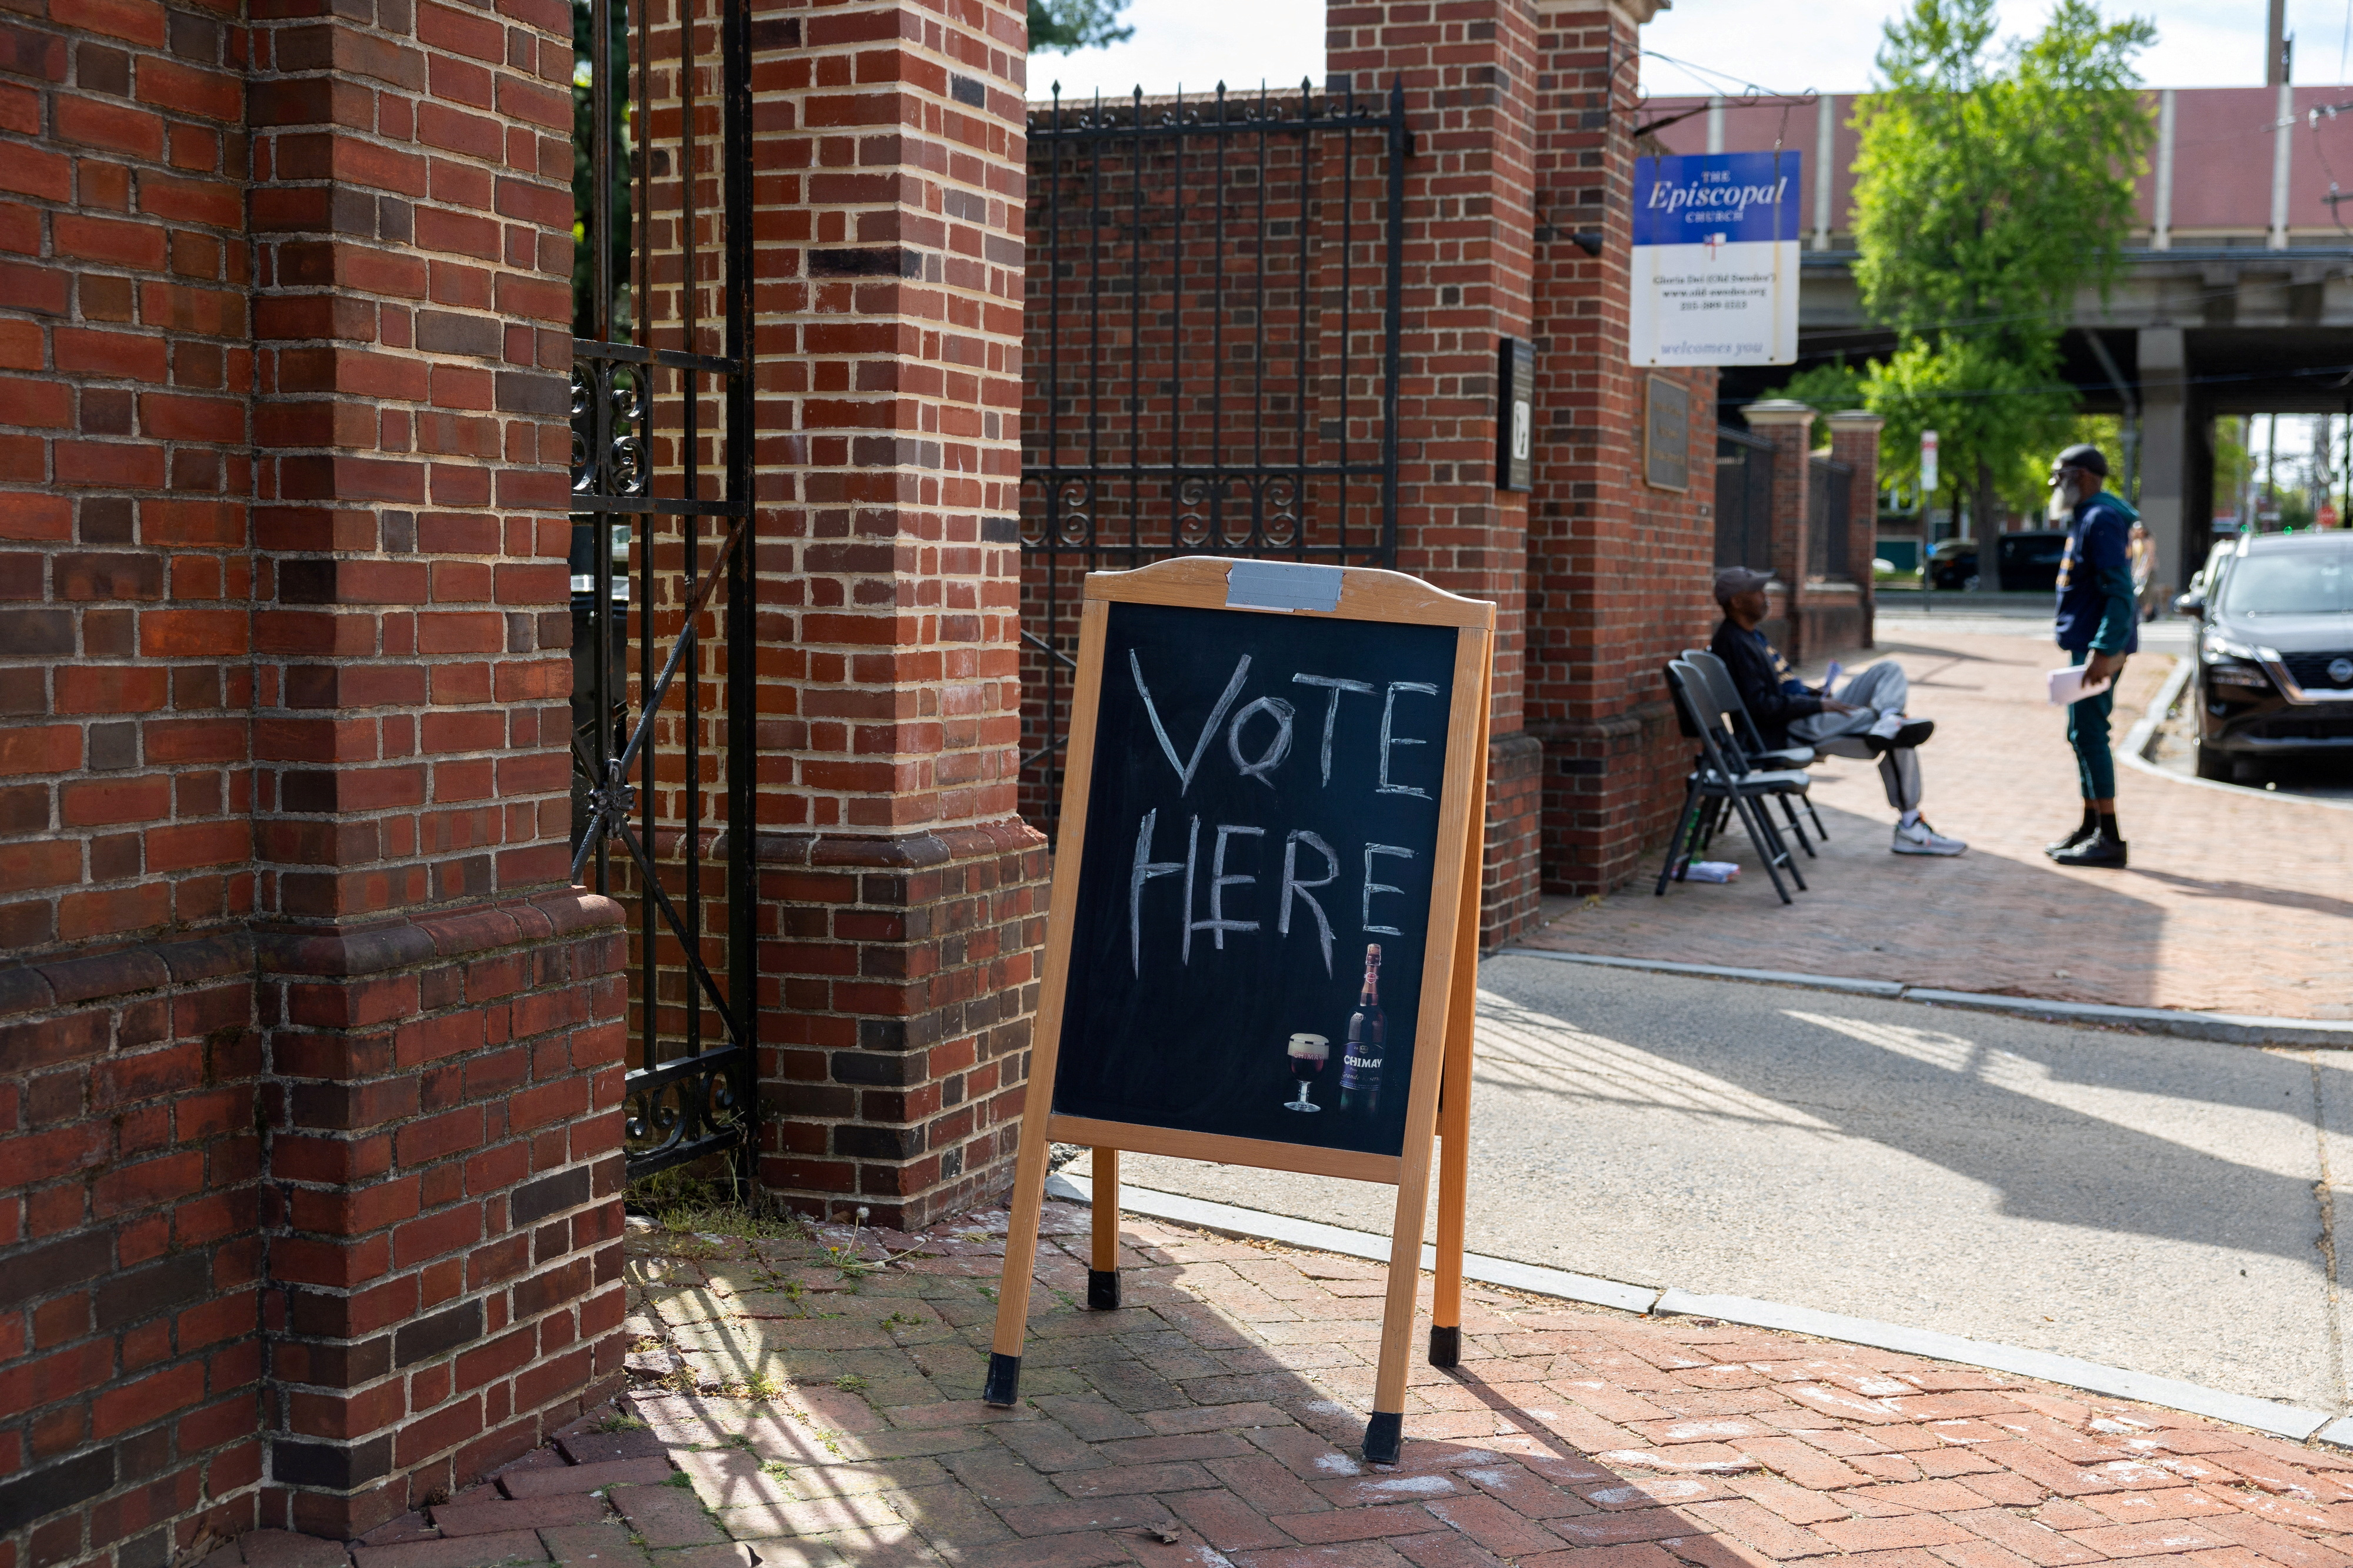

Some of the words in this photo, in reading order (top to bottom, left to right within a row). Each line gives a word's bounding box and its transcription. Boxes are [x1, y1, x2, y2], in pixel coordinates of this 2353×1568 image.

[1702, 171, 1730, 182] THE
[1647, 176, 1788, 213] Episcopal
[1686, 210, 1744, 223] CHURCH
[1661, 341, 1732, 354] welcomes
[1735, 342, 1764, 356] you
[1129, 648, 1441, 800] VOTE
[1129, 807, 1419, 980] HERE
[1293, 1050, 1324, 1060] CHIMAY
[1344, 1055, 1382, 1068] CHIMAY
[1341, 1071, 1360, 1080] Grande
